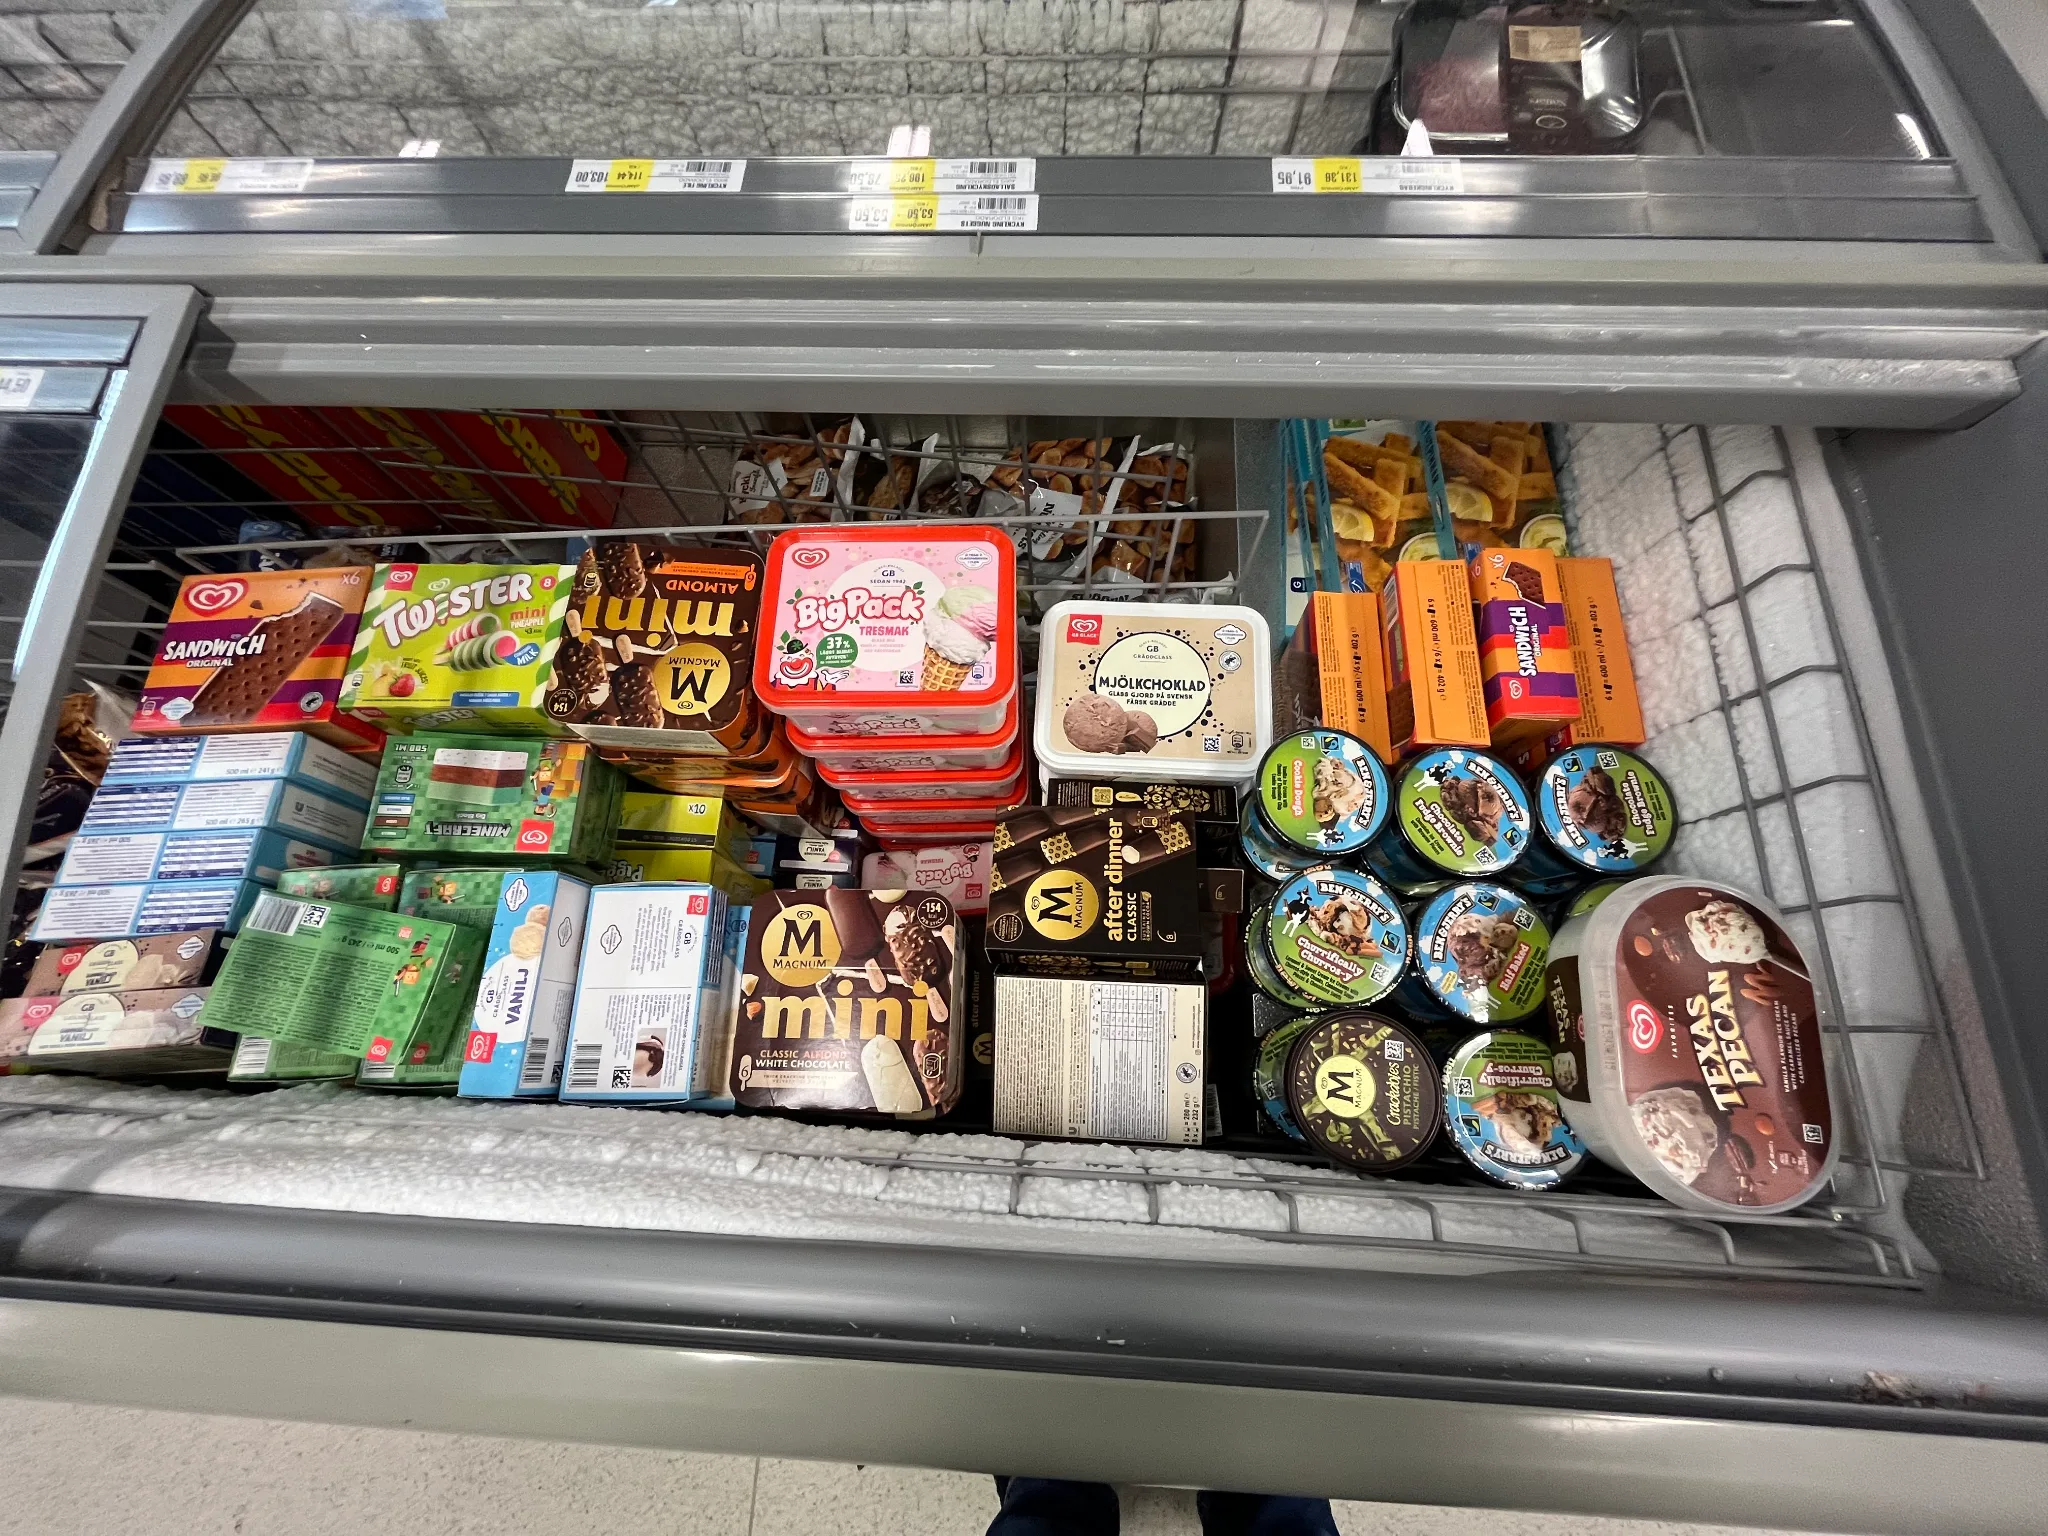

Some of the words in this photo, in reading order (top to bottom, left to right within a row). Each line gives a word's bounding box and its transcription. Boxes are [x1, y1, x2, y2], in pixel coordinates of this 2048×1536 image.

[577, 171, 609, 182] 103,00
[341, 571, 361, 585] x6
[543, 577, 551, 588] 8
[881, 569, 896, 578] GB
[666, 580, 739, 595] ALMOND
[509, 605, 546, 620] mini
[579, 596, 735, 647] mini
[510, 617, 545, 629] PINEAPPLE
[859, 625, 909, 636] TRESMAK
[1430, 619, 1438, 632] 600
[163, 633, 267, 662] SANDWICH
[826, 636, 851, 650] 37%
[1146, 645, 1159, 653] GB
[1508, 606, 1538, 677] SANDWICH
[1534, 623, 1543, 658] ORIGINAL
[186, 657, 234, 668] ORIGINAL
[516, 648, 539, 667] MILK
[669, 656, 721, 668] MAGNUM
[1599, 664, 1609, 678] 600
[1098, 674, 1206, 692] MJÖLKCHOKLAD
[1126, 697, 1148, 705] FÄRSK
[1149, 698, 1177, 706] GRÄDDE
[1130, 691, 1154, 699] GJORD
[1156, 690, 1165, 699] PÅ
[1166, 692, 1193, 700] SVENSK
[1355, 690, 1364, 702] 600
[553, 702, 568, 713] 154
[393, 744, 408, 752] ML
[410, 744, 429, 753] 500
[1293, 760, 1303, 789] Cookie
[1356, 759, 1371, 780] BEN
[1468, 761, 1488, 780] BEN
[1627, 771, 1647, 808] Brownie
[1291, 789, 1303, 817] Dough
[1621, 782, 1641, 826] Chocolate
[424, 821, 512, 839] MINECRAFT
[1414, 799, 1435, 825] Fudge
[1434, 820, 1464, 857] Brownie
[1430, 803, 1463, 842] Chocolate
[1640, 808, 1655, 835] Fudge
[1567, 824, 1585, 846] BEN
[1103, 817, 1123, 884] dinner
[1073, 881, 1084, 929] MAGNUM
[1320, 883, 1343, 895] BEN
[1352, 890, 1389, 922] JERRY'S
[1103, 886, 1123, 942] after
[1127, 892, 1137, 942] CLASSIC
[1433, 936, 1446, 960] BEN
[1442, 897, 1473, 932] JERRY'S
[684, 932, 692, 945] GB
[772, 958, 827, 969] MAGNUM
[1298, 936, 1365, 977] Churrifically
[1300, 949, 1354, 983] Churros-y
[1500, 969, 1516, 991] Half
[1509, 943, 1530, 973] Baked
[486, 989, 496, 1004] GB
[505, 968, 529, 1025] VANILJ
[1553, 974, 1570, 1029] TEXAS
[81, 1003, 95, 1012] GB
[761, 979, 929, 1041] mini
[1549, 990, 1565, 1044] PECAN
[1667, 1004, 1678, 1058] FAVORITES
[1707, 969, 1764, 1087] PECAN
[1776, 1024, 1784, 1034] ICE
[760, 1050, 799, 1059] CLASSIC
[803, 1050, 847, 1059] ALMOND
[1686, 993, 1746, 1111] TEXAS
[1786, 1042, 1796, 1072] CARAMEL
[1794, 1039, 1805, 1084] CARAMELIZED
[741, 1063, 749, 1078] 6
[755, 1059, 789, 1069] WHITE
[790, 1060, 850, 1069] CHOCOLATE
[1486, 1062, 1543, 1077] Churros-y
[1355, 1068, 1363, 1109] MAGNUM
[1479, 1071, 1553, 1088] Churrifically
[1781, 1066, 1790, 1093] VANILLA
[1789, 1073, 1798, 1090] WITH
[1403, 1065, 1411, 1126] PISTACHIO
[1191, 1109, 1199, 1121] 232
[1484, 1143, 1532, 1165] JERRY'S
[1541, 1146, 1567, 1163] BEN
